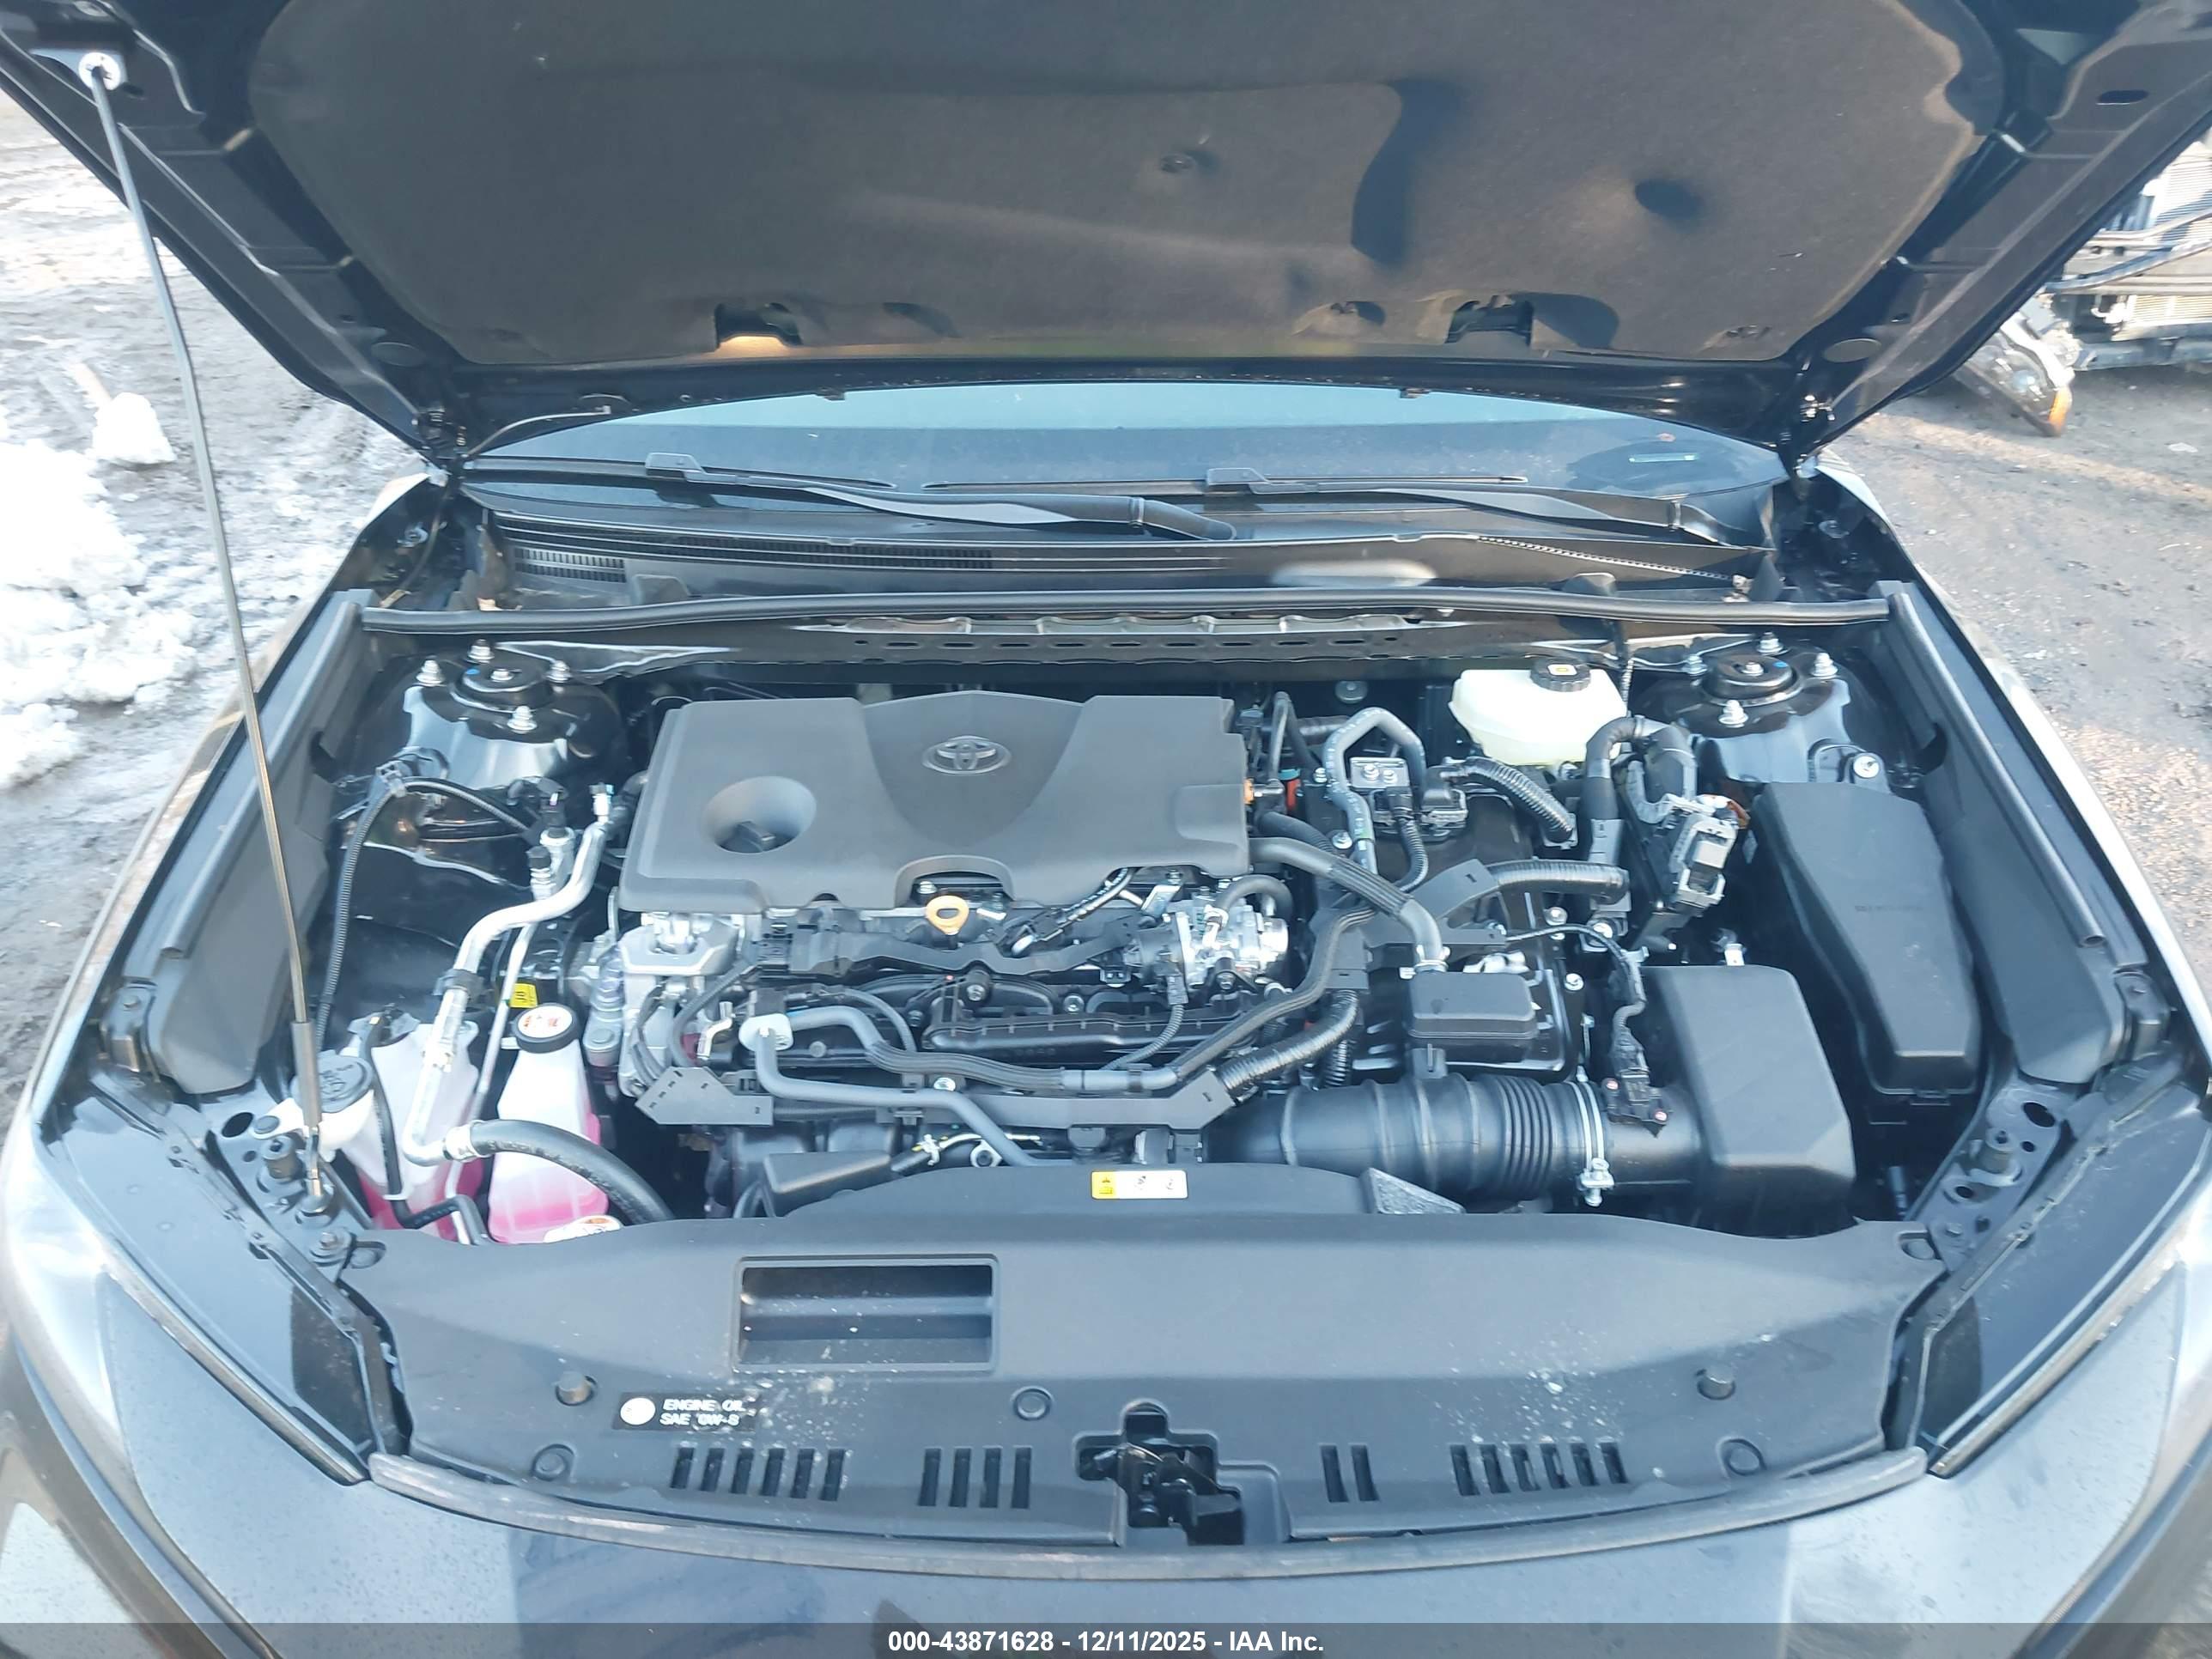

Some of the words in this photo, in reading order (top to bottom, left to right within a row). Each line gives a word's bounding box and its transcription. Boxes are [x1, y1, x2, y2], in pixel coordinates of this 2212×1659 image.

[663, 1399, 716, 1412] ENGINE
[721, 1400, 746, 1412] OIL
[659, 1413, 691, 1425] SAE
